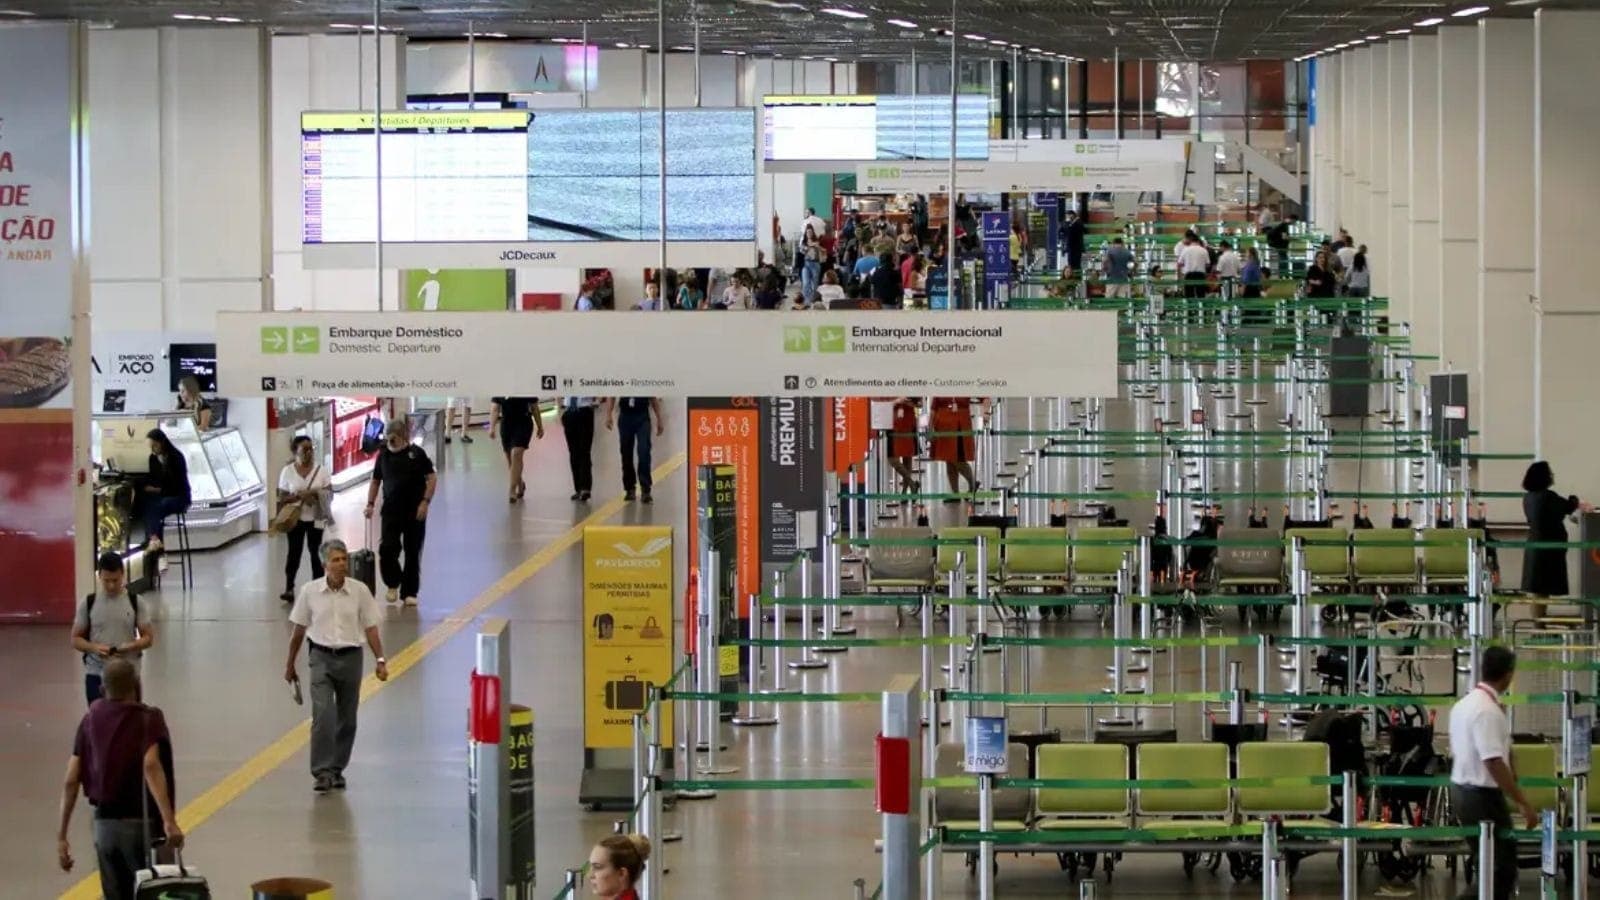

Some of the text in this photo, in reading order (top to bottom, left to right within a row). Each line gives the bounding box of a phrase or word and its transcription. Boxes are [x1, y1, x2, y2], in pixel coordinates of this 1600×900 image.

[7, 250, 52, 261] ANDAR
[499, 250, 557, 261] JCDecaux
[329, 326, 463, 340] Embarque Doméstico
[851, 326, 1003, 339] Embarque Internacional
[329, 343, 441, 355] Domestic Departure
[852, 342, 976, 354] International Departure
[311, 380, 336, 389] Praça
[338, 380, 349, 388] de
[351, 379, 405, 389] alimentação
[411, 379, 433, 388] Food
[434, 380, 457, 388] court
[579, 377, 624, 387] Sanitários
[631, 378, 675, 387] Restrooms
[823, 378, 883, 387] Atendimento
[897, 378, 928, 387] cliente
[933, 378, 976, 387] Customer
[977, 378, 1008, 387] Service
